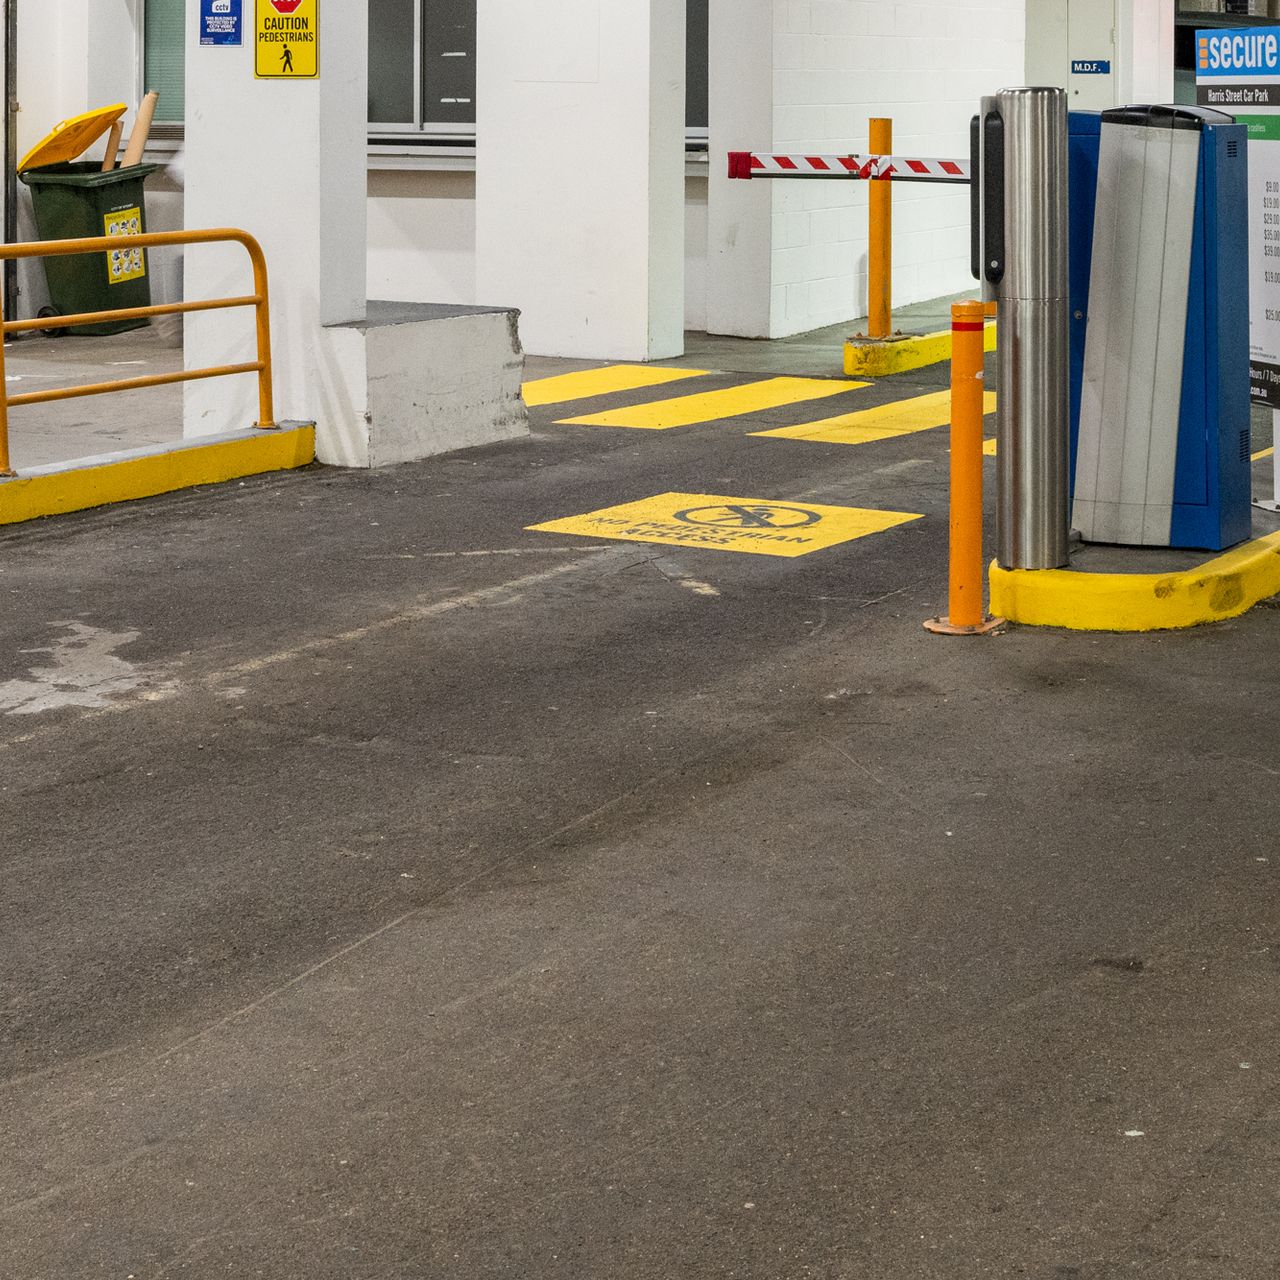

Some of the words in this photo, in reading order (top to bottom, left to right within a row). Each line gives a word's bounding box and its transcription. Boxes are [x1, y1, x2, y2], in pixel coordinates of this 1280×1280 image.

[264, 17, 308, 30] CAUTION
[259, 32, 314, 42] PEDESTRIANS
[1210, 35, 1277, 68] secure
[1074, 63, 1101, 71] M.D.F.
[1208, 90, 1224, 102] Harris
[1226, 89, 1242, 102] Street
[1243, 89, 1254, 102] Car
[1255, 89, 1269, 102] Park
[1266, 181, 1279, 193] $9.00
[1263, 197, 1279, 208] $19.00
[1263, 213, 1280, 225] $29.00
[1264, 229, 1280, 241] $35.00
[1264, 245, 1280, 257] $39.00
[634, 521, 813, 544] PEDESTRIAN
